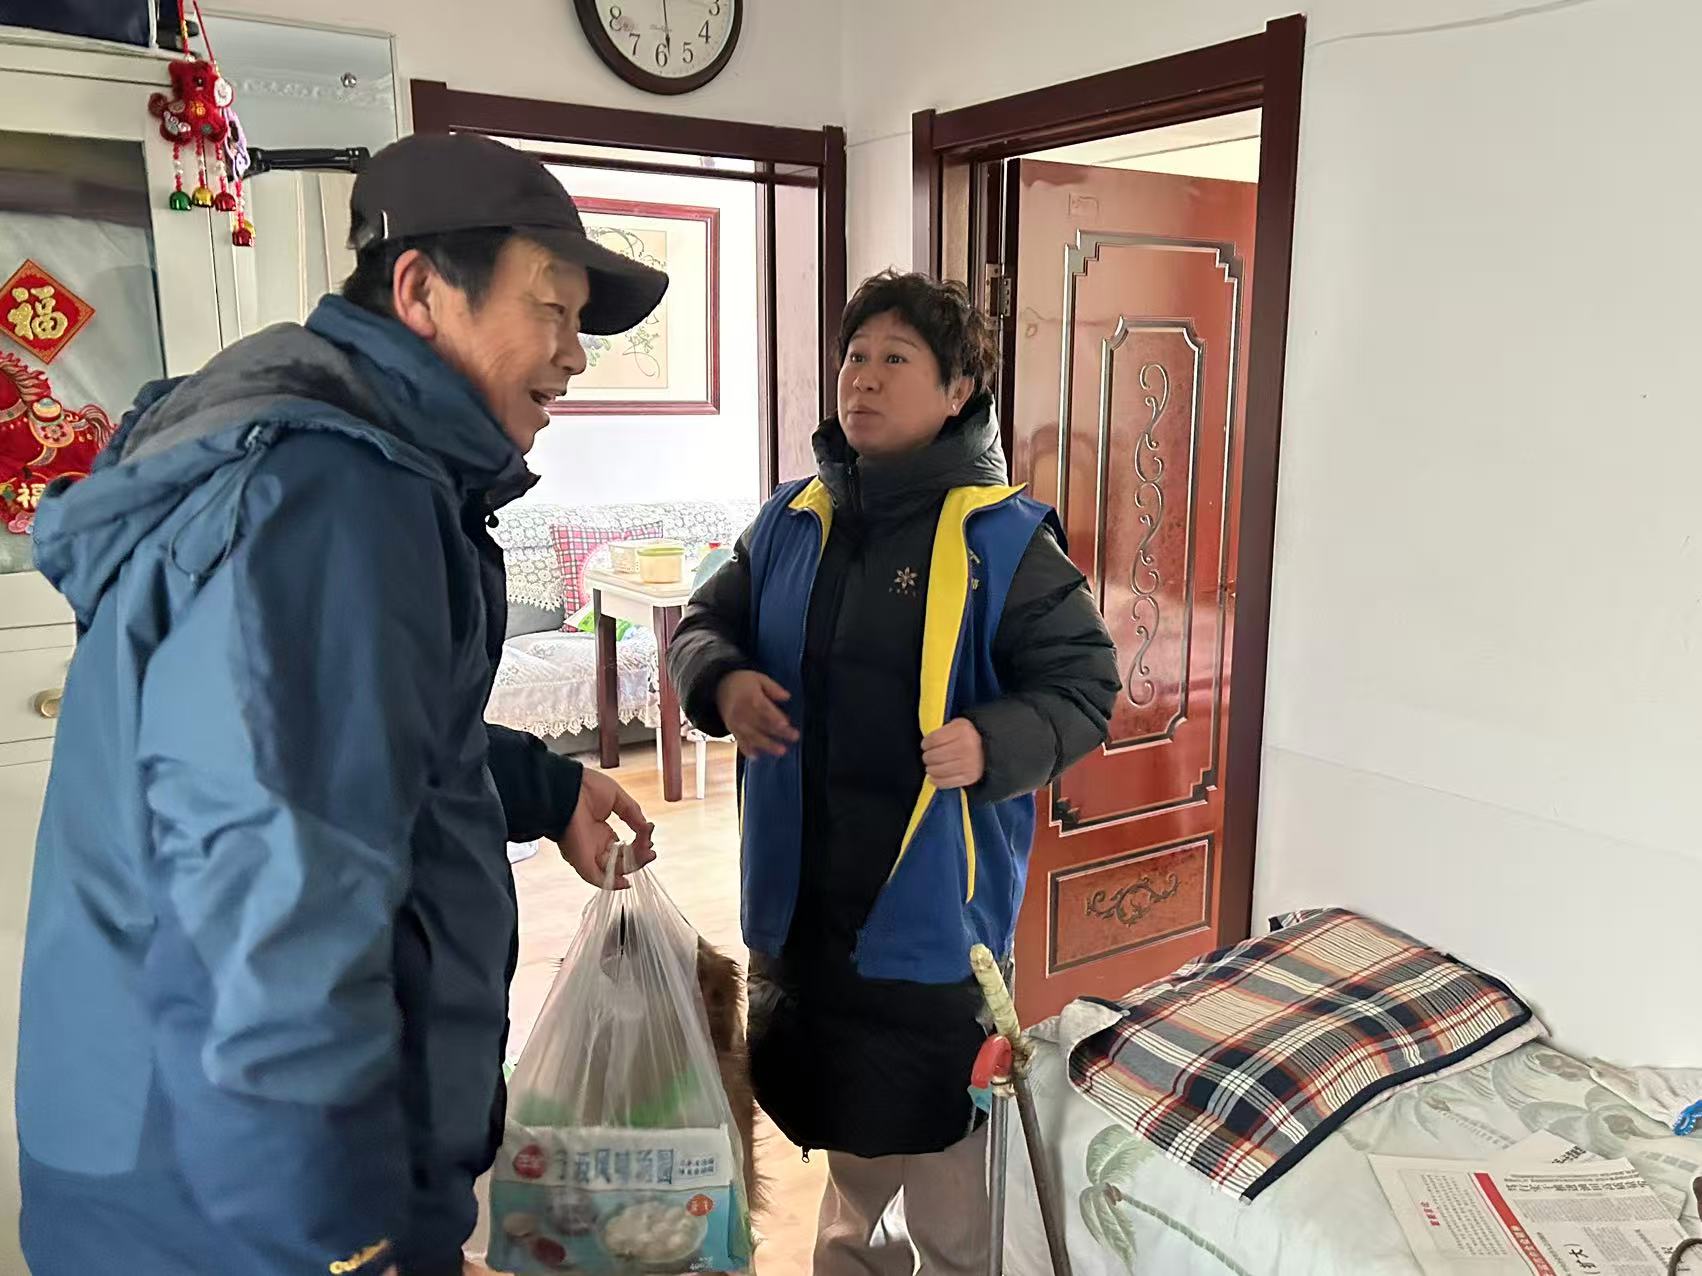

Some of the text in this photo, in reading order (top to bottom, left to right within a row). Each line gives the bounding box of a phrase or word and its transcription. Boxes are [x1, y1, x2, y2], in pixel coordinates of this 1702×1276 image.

[609, 5, 622, 32] 8
[708, 0, 721, 16] 3
[698, 19, 711, 44] 4
[629, 33, 641, 56] 7
[655, 42, 668, 67] 6
[682, 41, 694, 64] 5
[8, 285, 68, 340] 福
